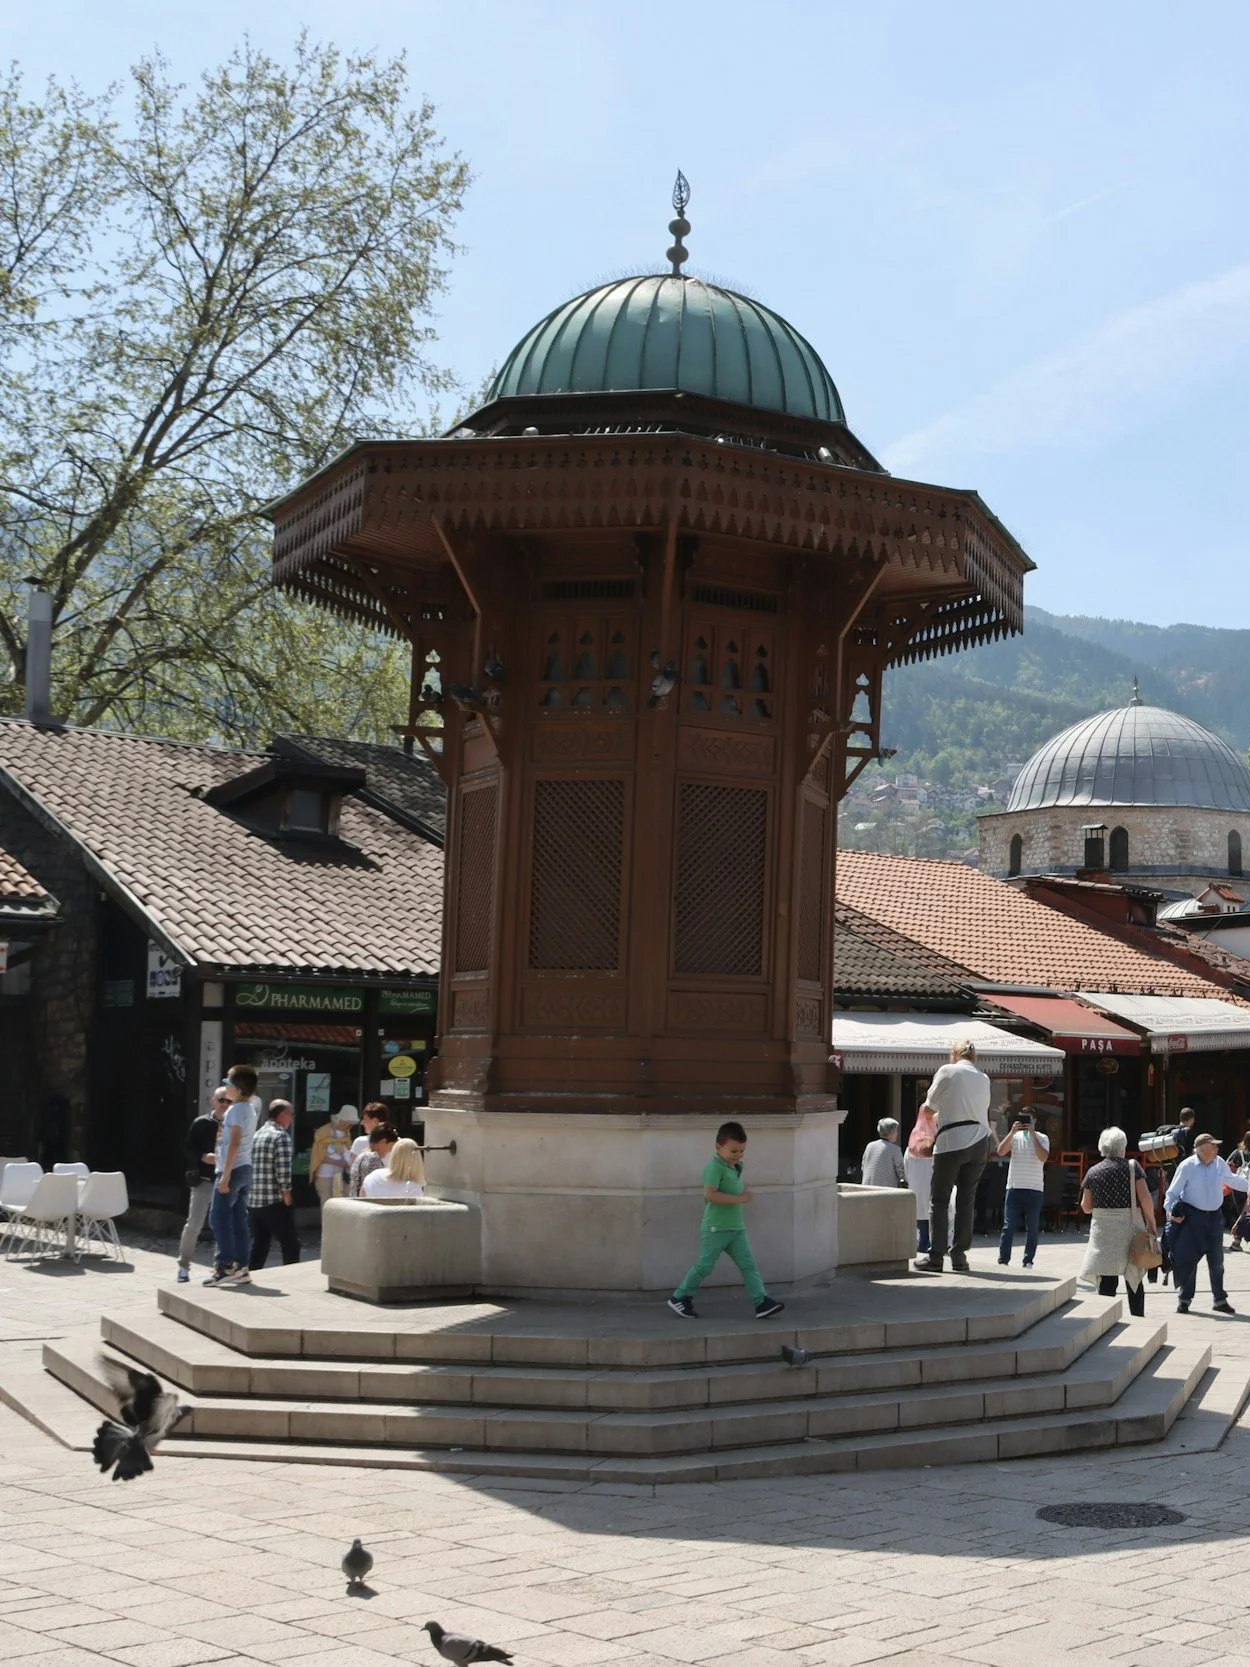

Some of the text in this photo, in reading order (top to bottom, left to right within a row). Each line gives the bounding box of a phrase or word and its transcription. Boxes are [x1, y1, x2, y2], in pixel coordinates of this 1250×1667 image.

[271, 993, 362, 1010] PHARMAMED
[1081, 1039, 1113, 1053] PAŞA
[261, 1056, 316, 1072] apoteka
